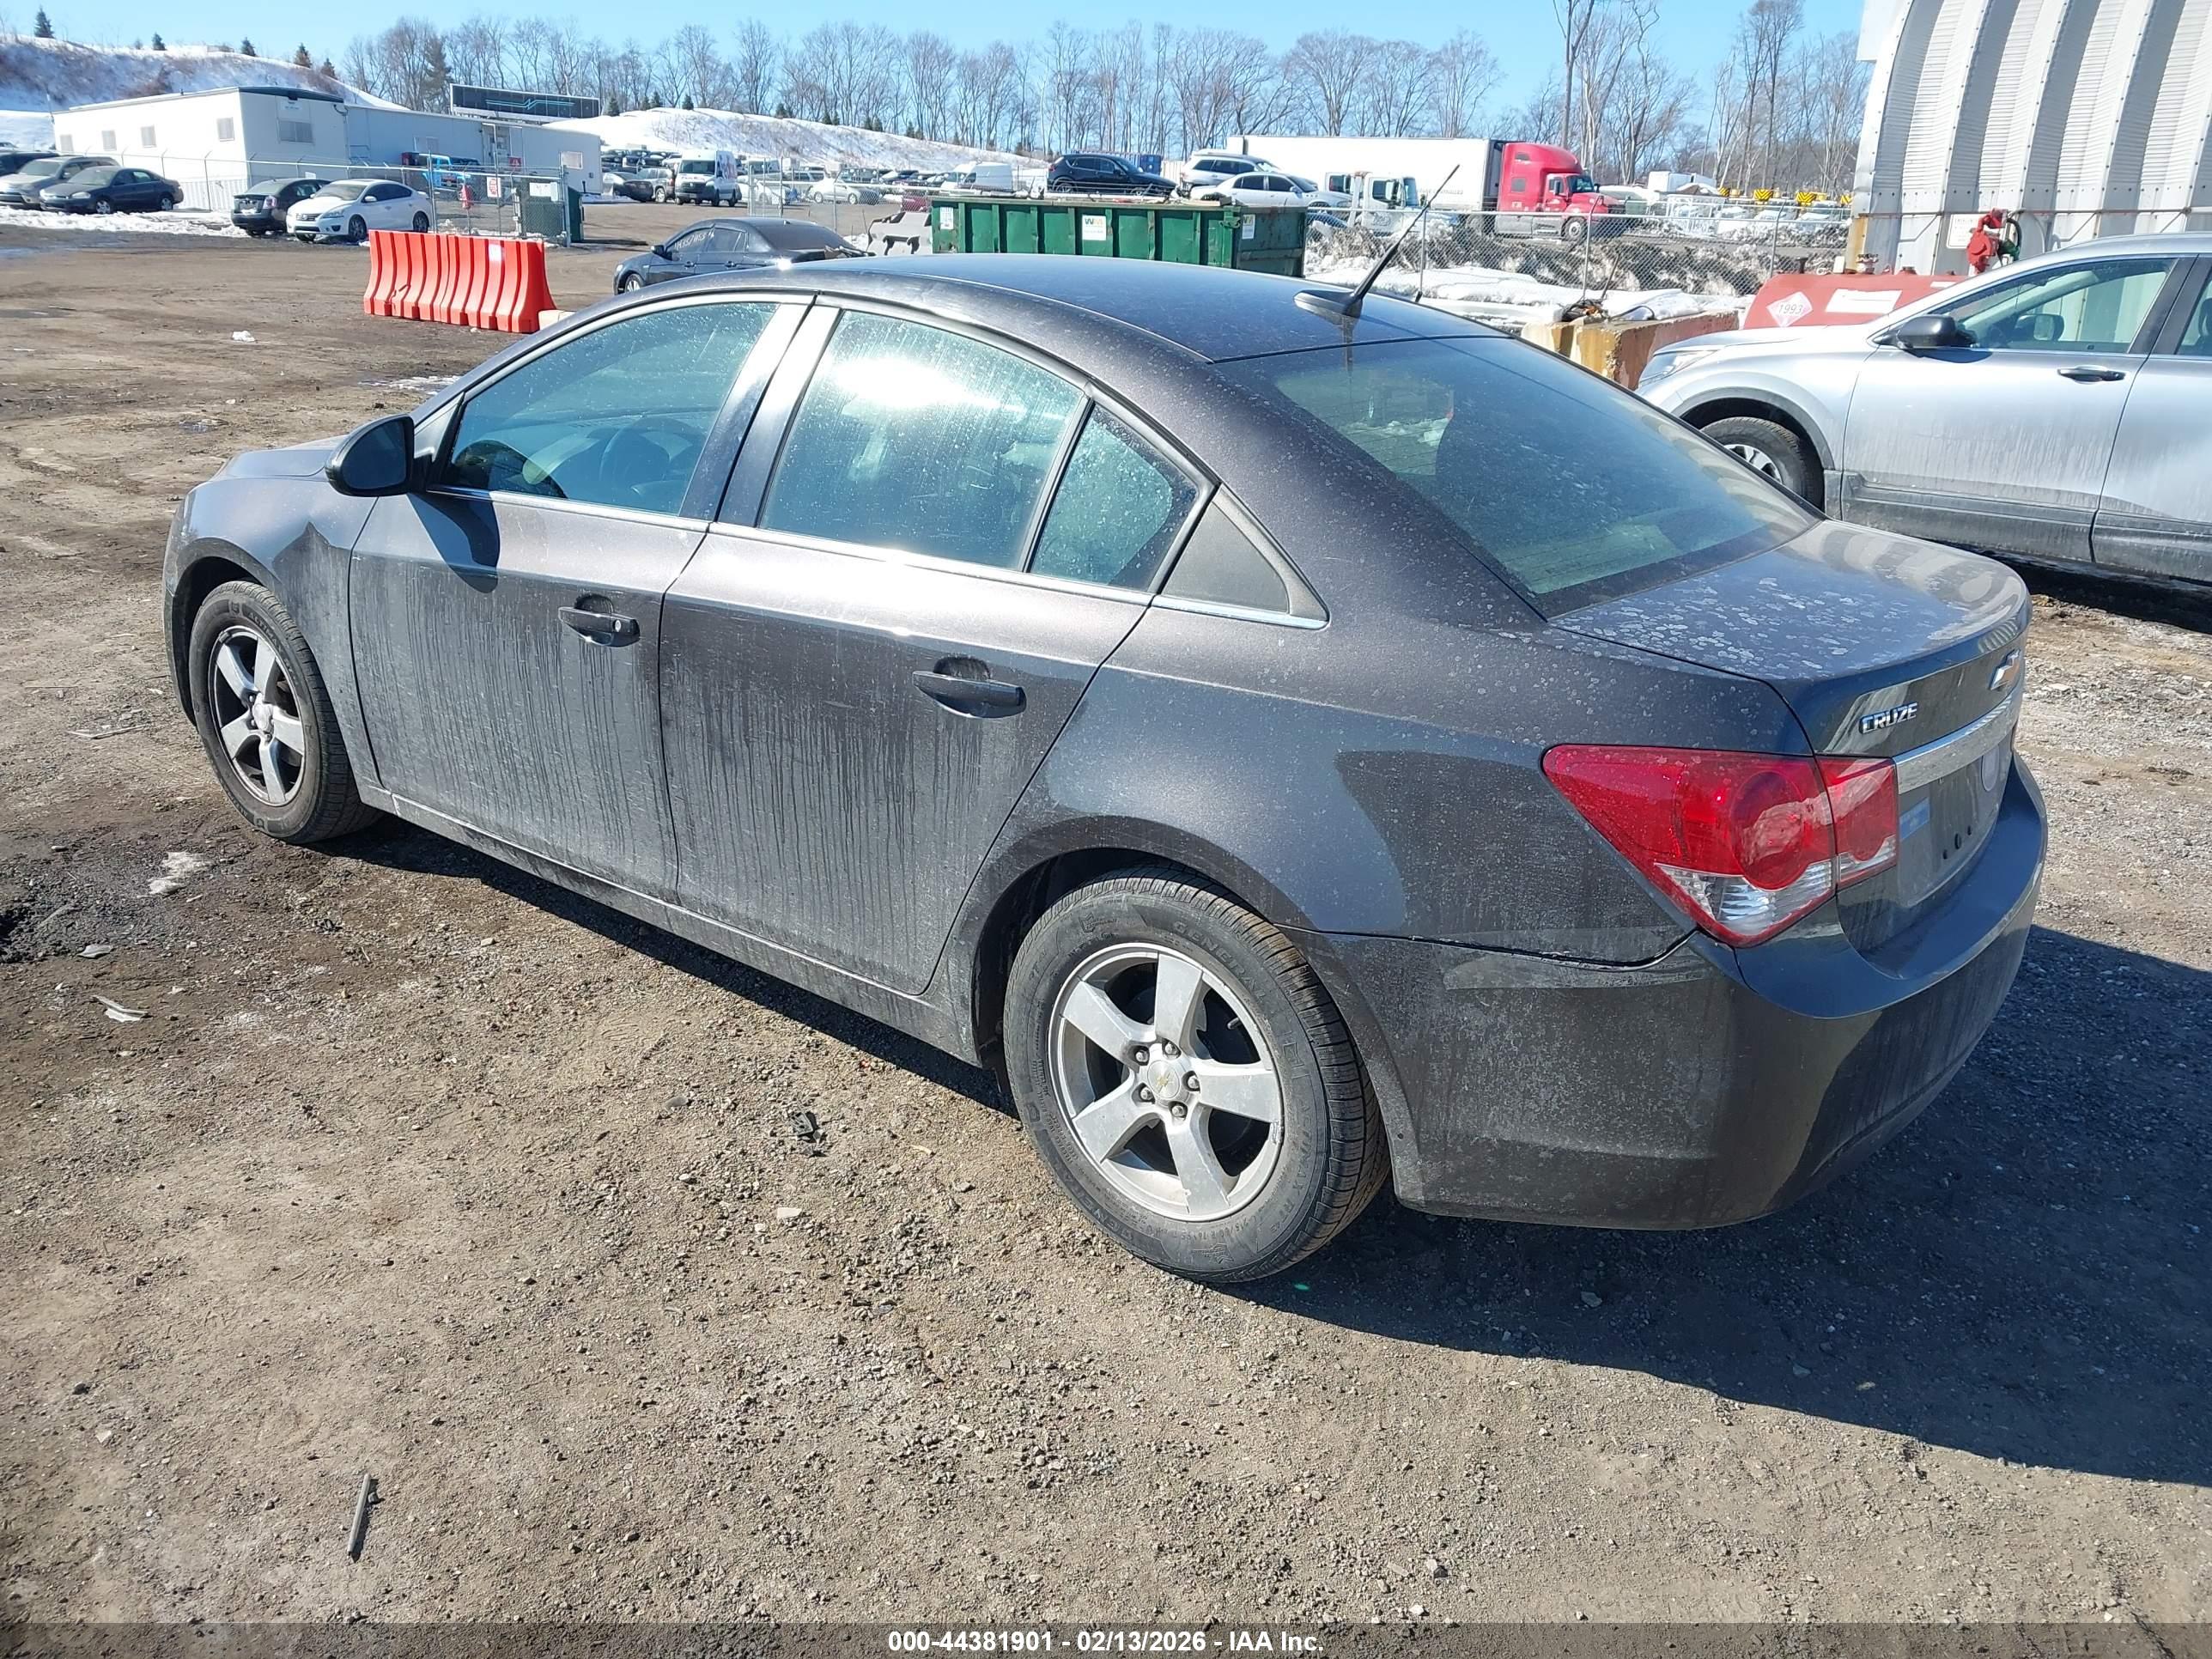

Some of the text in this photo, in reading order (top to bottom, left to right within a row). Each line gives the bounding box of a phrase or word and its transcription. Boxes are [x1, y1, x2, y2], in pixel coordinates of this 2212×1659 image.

[1778, 303, 1803, 314] 1993
[1860, 702, 1917, 734] CRUZE
[1173, 919, 1267, 1004] GENERAL
